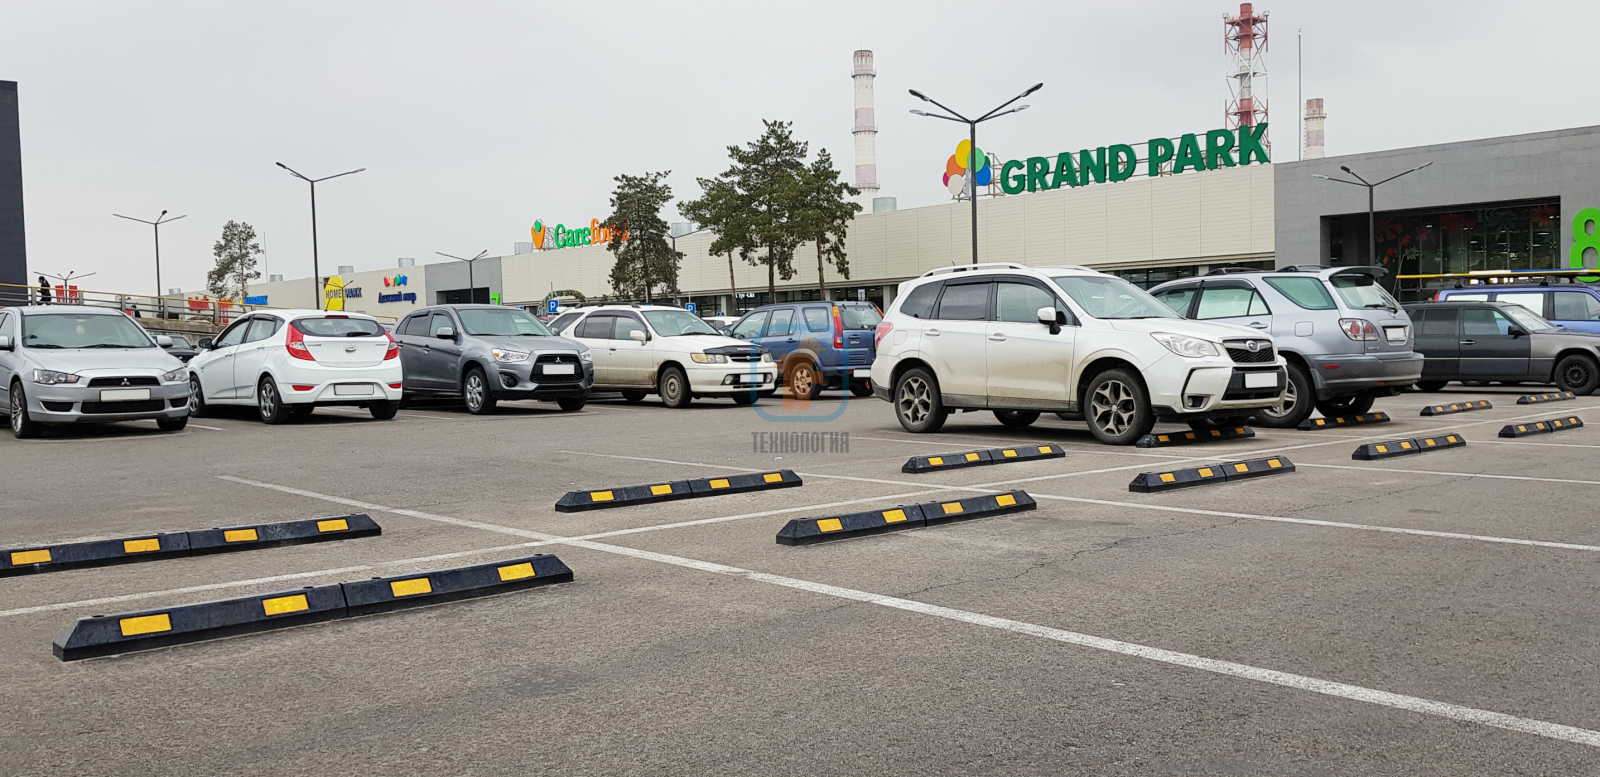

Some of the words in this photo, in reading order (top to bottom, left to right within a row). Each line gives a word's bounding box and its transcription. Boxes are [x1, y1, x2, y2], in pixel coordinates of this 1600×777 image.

[1000, 143, 1136, 195] GRAND
[1148, 122, 1271, 177] PARK
[1569, 207, 1600, 283] 8
[325, 289, 342, 299] HOME
[345, 287, 362, 299] PARK
[490, 292, 500, 305] 7
[550, 301, 557, 311] P
